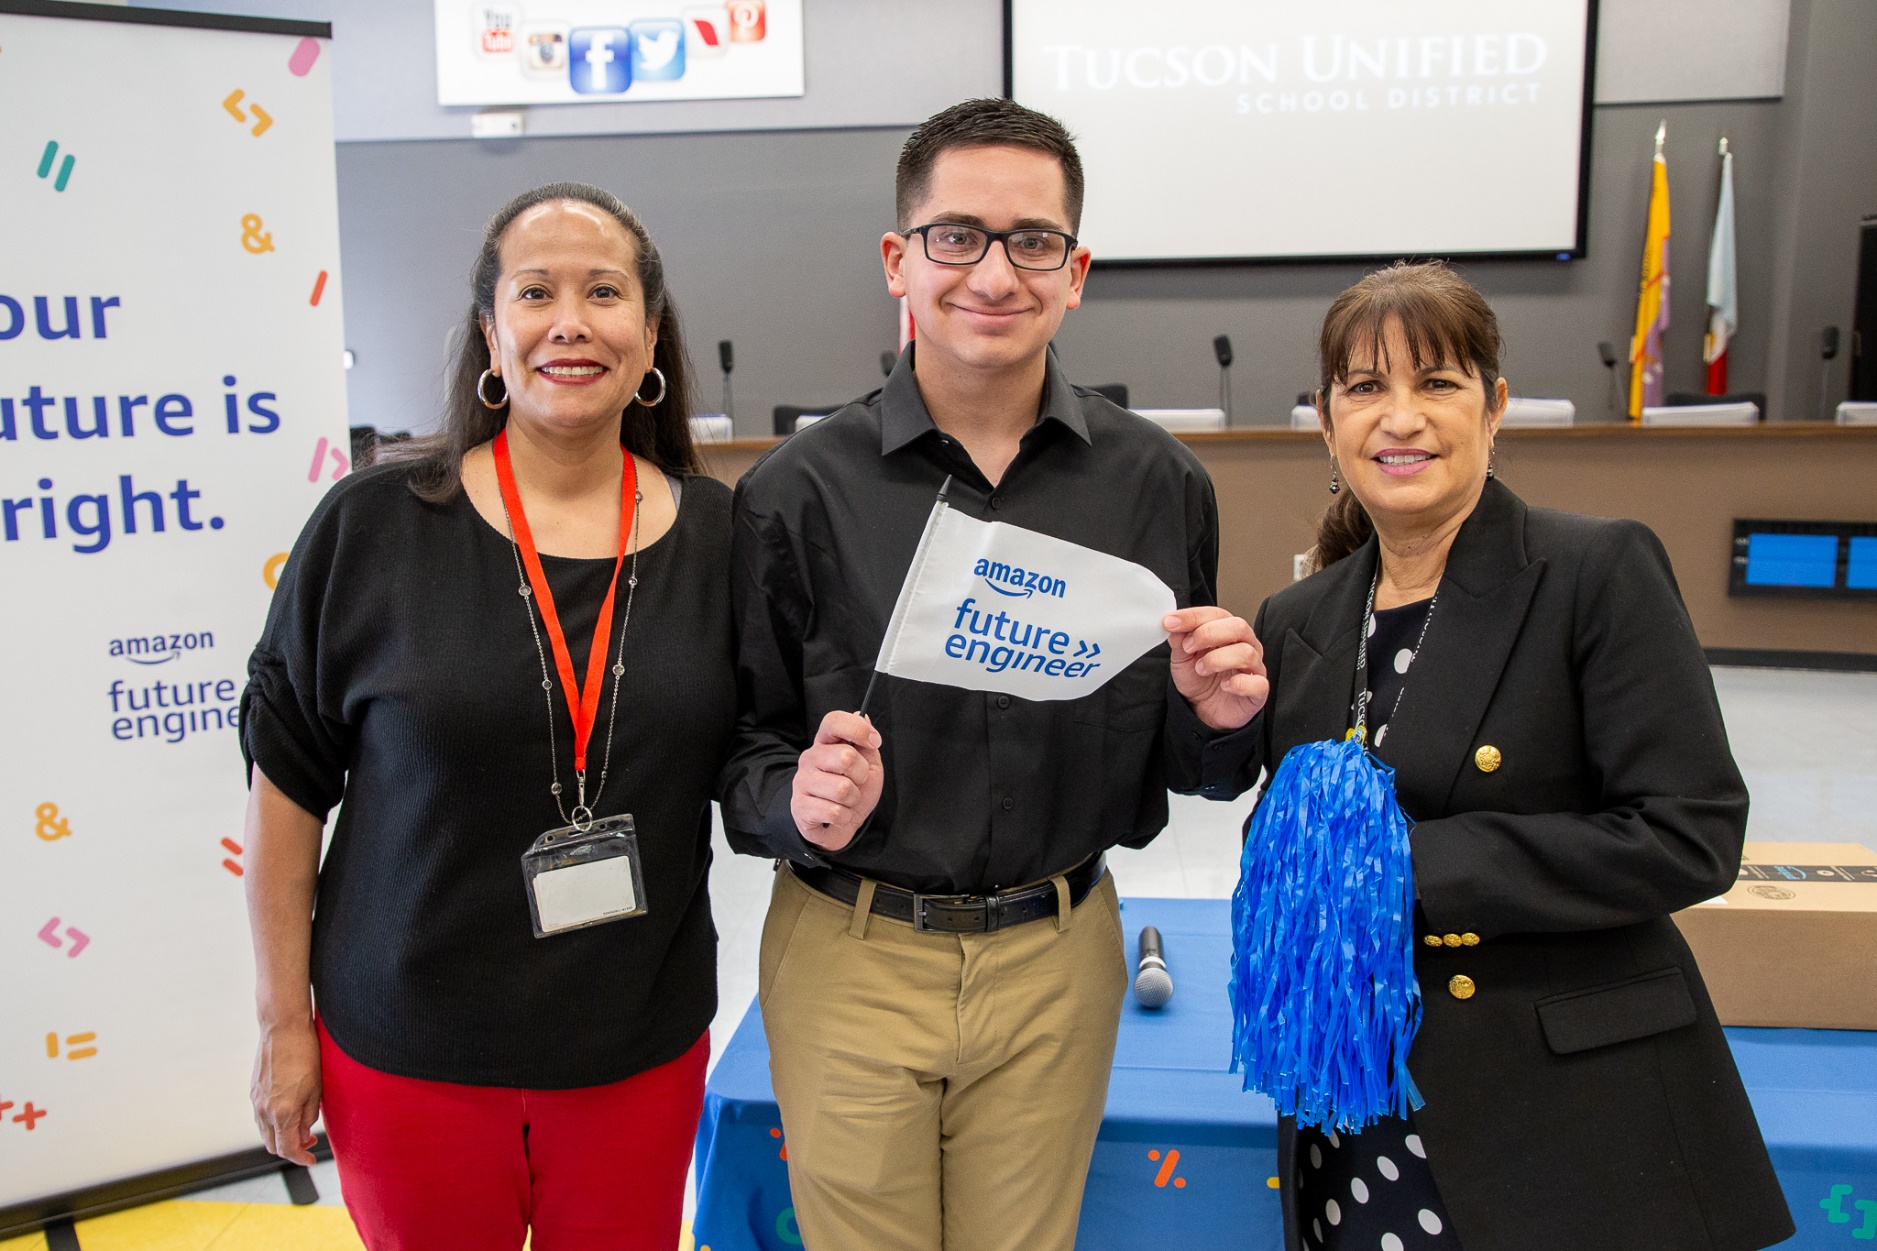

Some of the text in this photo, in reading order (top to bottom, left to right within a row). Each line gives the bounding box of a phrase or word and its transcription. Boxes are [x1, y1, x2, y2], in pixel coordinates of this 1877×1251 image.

[1042, 32, 1548, 91] TUCSON UNIFIED
[1236, 82, 1542, 115] SCHOOL DISTRICT
[222, 375, 281, 434] is
[974, 558, 1066, 598] amazon
[109, 631, 214, 657] amazon
[954, 598, 1070, 655] future
[945, 634, 1101, 678] engineer
[108, 679, 235, 713] future
